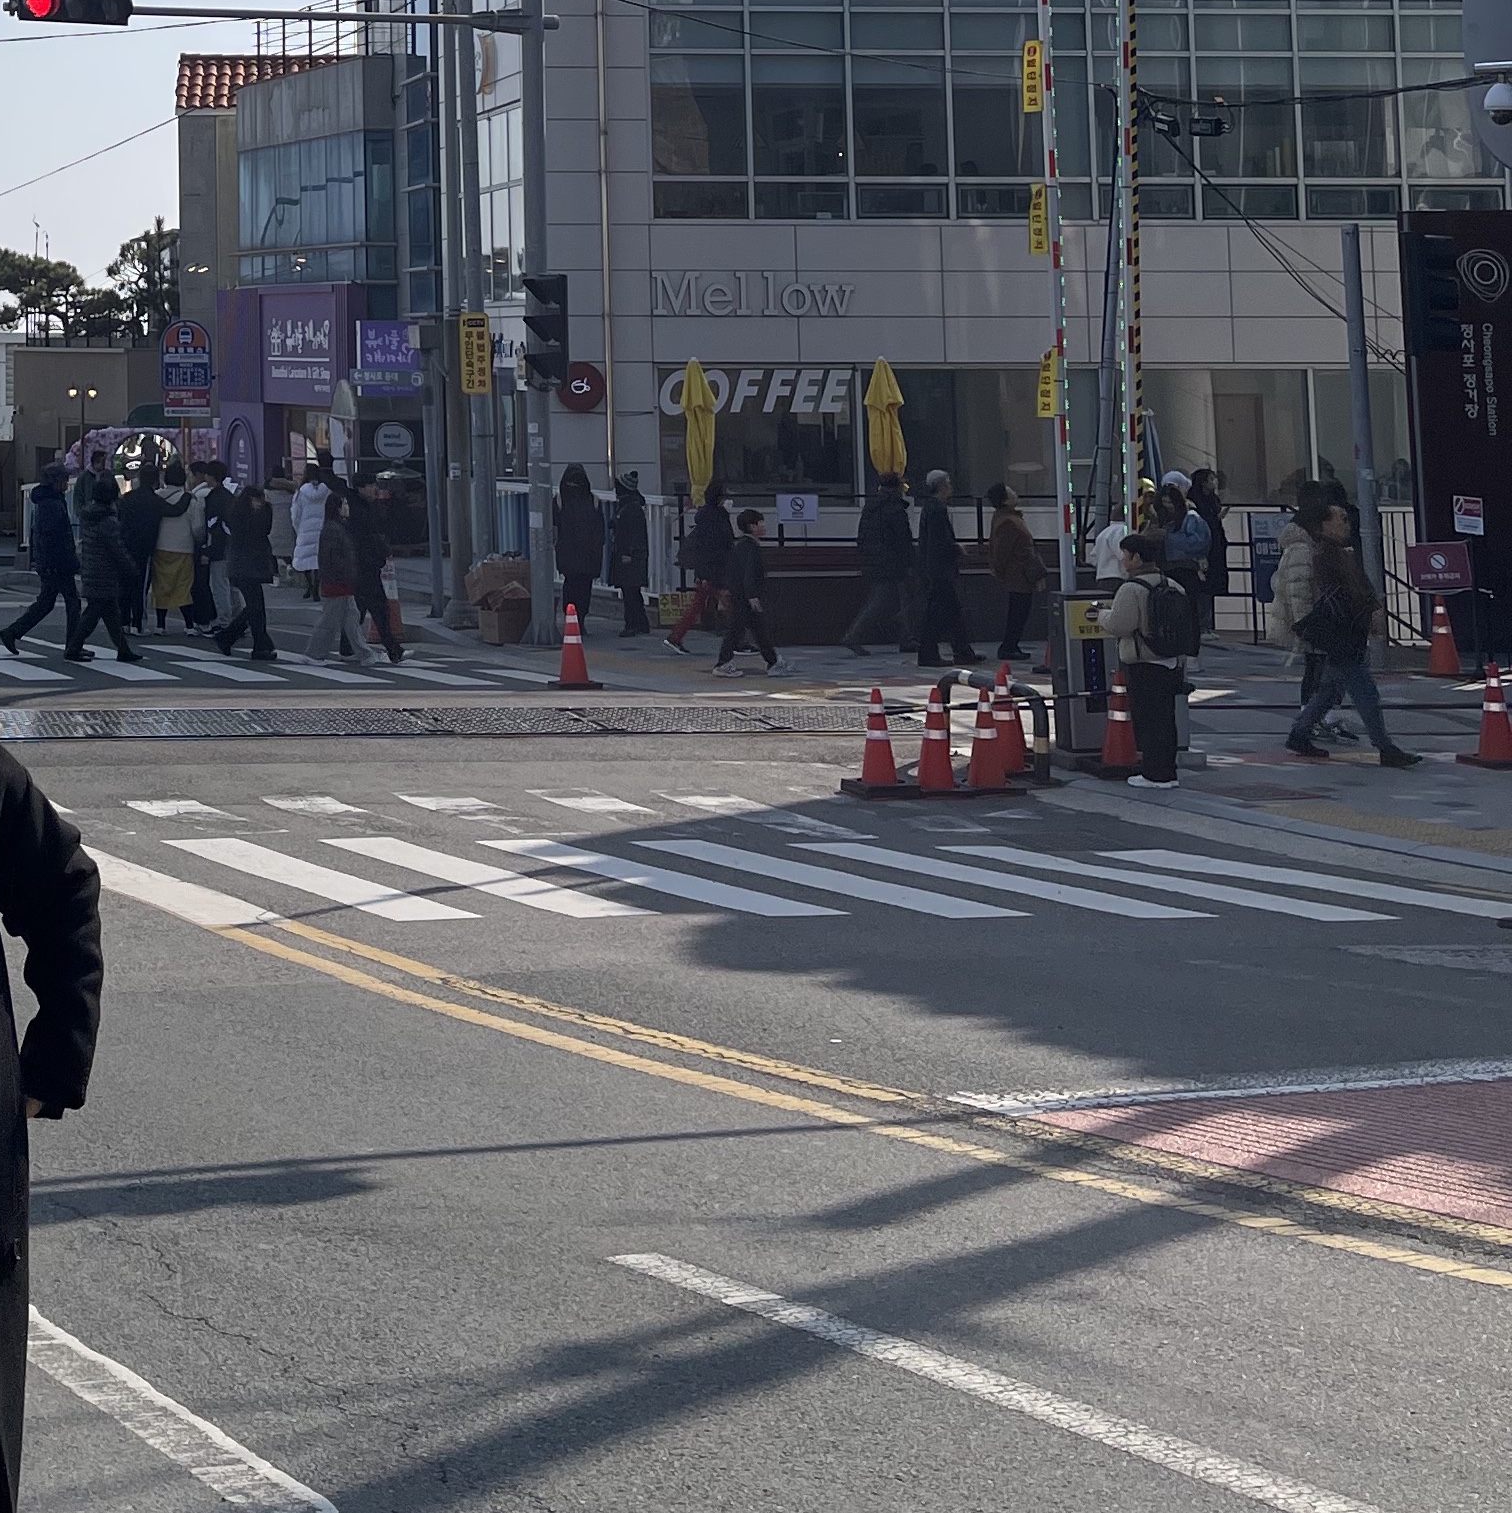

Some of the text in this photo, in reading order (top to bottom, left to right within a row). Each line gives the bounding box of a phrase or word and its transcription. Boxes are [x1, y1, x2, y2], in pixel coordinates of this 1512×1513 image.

[651, 271, 855, 317] Mellow
[659, 369, 853, 416] COFFEE
[1463, 374, 1480, 419] 정거장
[1482, 323, 1499, 436] Cheongsapo Station
